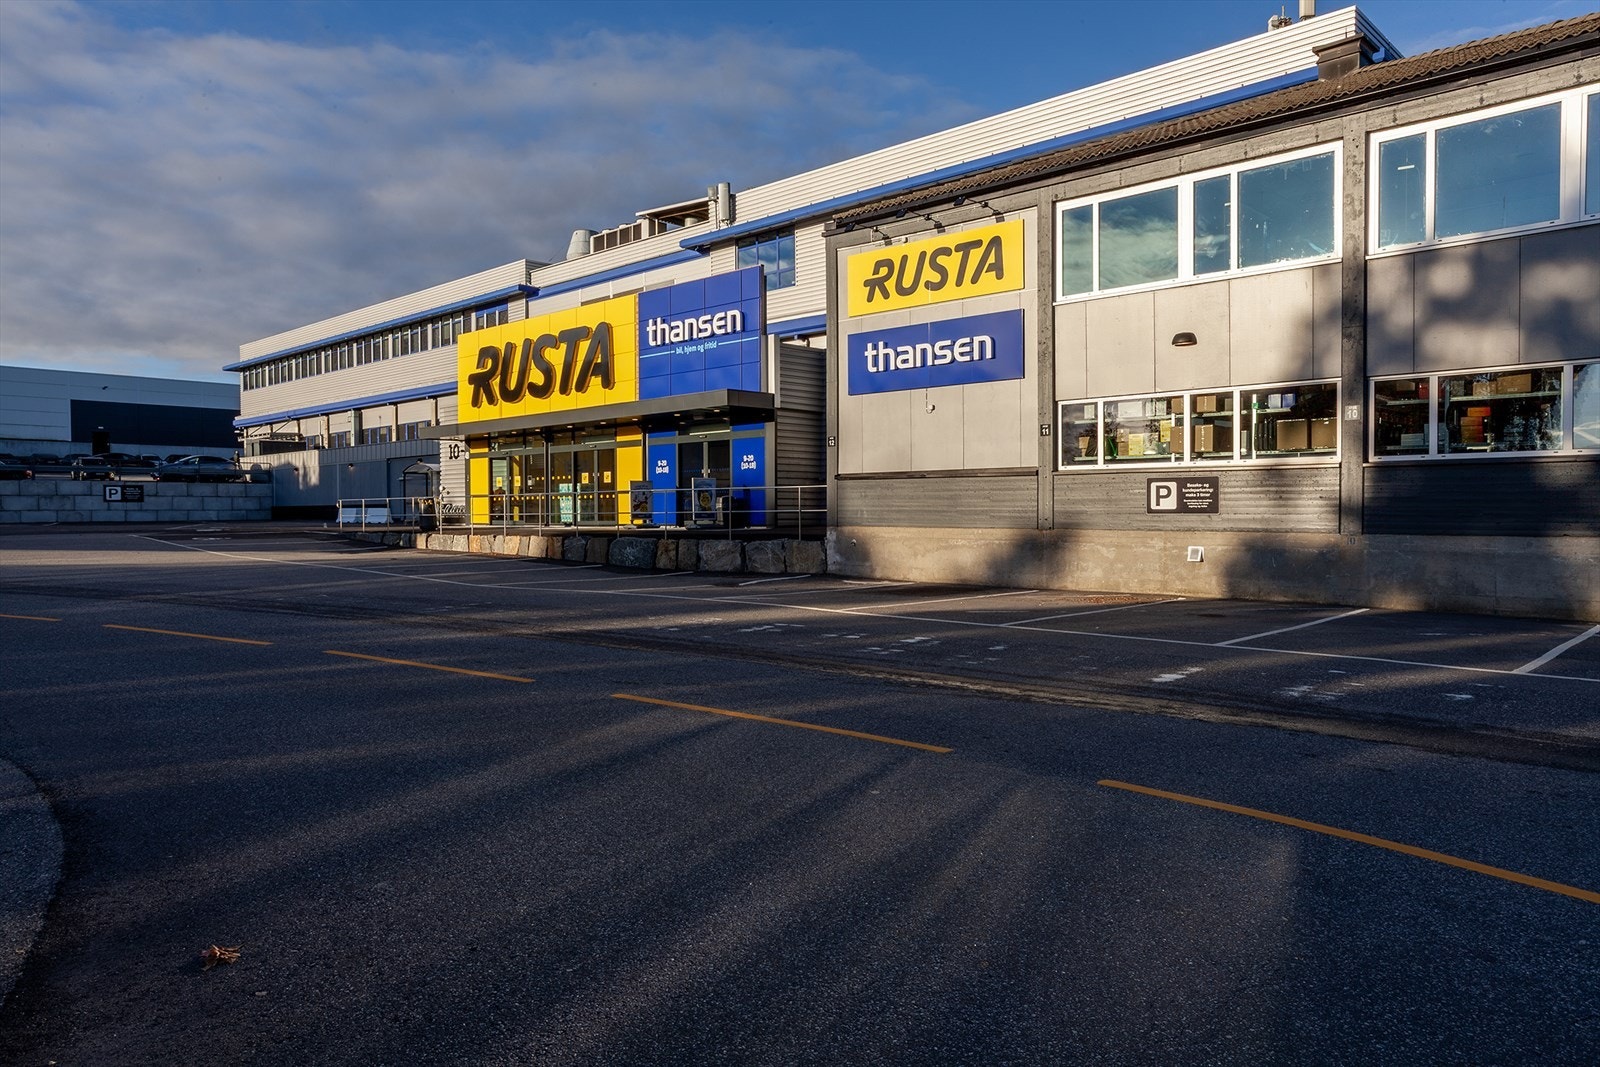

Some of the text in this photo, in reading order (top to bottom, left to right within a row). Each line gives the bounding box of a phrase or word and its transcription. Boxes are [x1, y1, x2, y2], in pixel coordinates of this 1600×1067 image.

[863, 235, 1004, 303] RUSTA
[646, 309, 742, 347] thansen
[684, 345, 697, 355] hjem
[697, 344, 705, 353] og
[704, 340, 717, 350] fritid
[864, 335, 994, 373] thansen
[468, 321, 615, 408] RUSTA
[1347, 409, 1358, 419] 10
[108, 488, 118, 499] P
[1155, 485, 1172, 506] P
